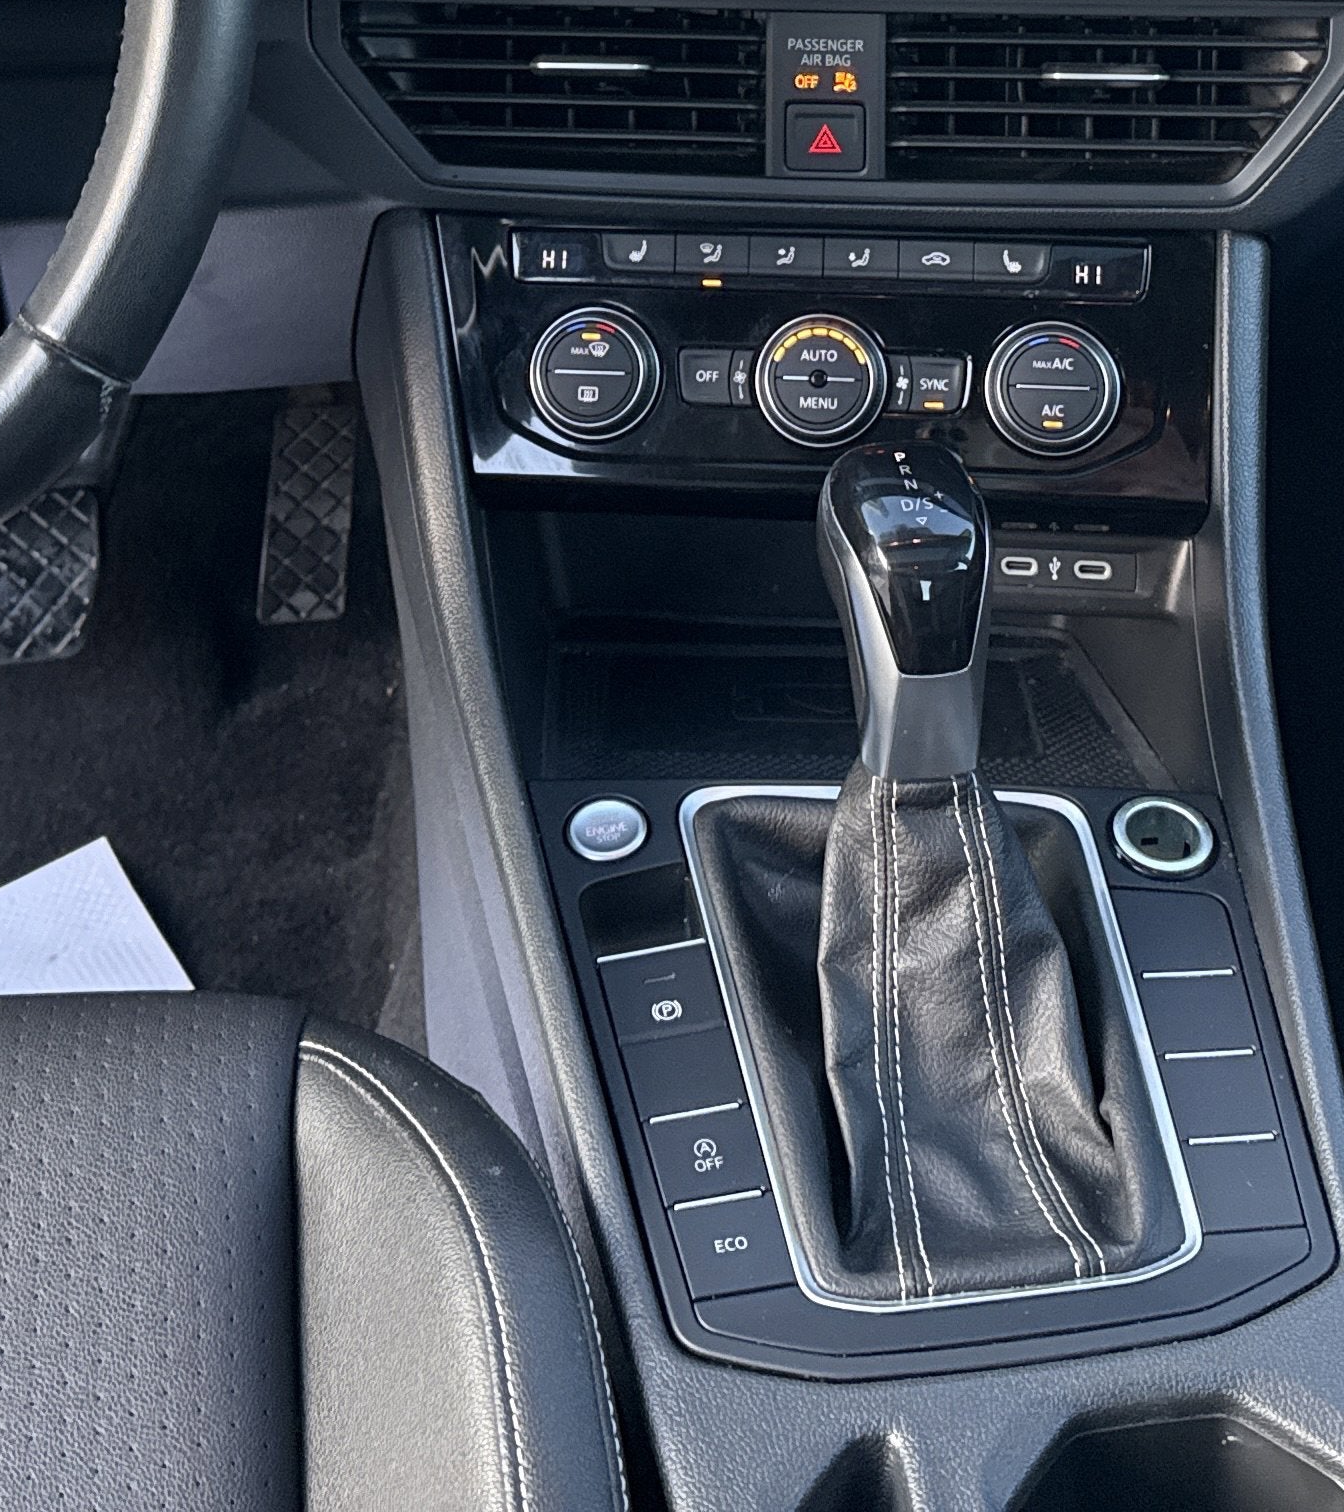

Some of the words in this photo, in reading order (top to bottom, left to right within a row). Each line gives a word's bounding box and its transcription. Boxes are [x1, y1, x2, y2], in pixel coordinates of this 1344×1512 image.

[787, 38, 864, 52] PASSENGER
[800, 54, 822, 66] AIR
[825, 55, 851, 67] BAG
[794, 74, 819, 89] OFF
[570, 346, 589, 355] MAX
[800, 349, 838, 363] AUTO
[695, 370, 719, 383] OFF
[919, 378, 949, 392] SYNC
[799, 396, 838, 410] MENU
[1041, 404, 1065, 417] A/C
[894, 451, 906, 463] P
[898, 464, 913, 476] R
[903, 478, 919, 491] N
[900, 496, 934, 512] D/S
[585, 821, 628, 837] ENGINE
[694, 1155, 724, 1173] OFF
[714, 1235, 749, 1254] ECO
